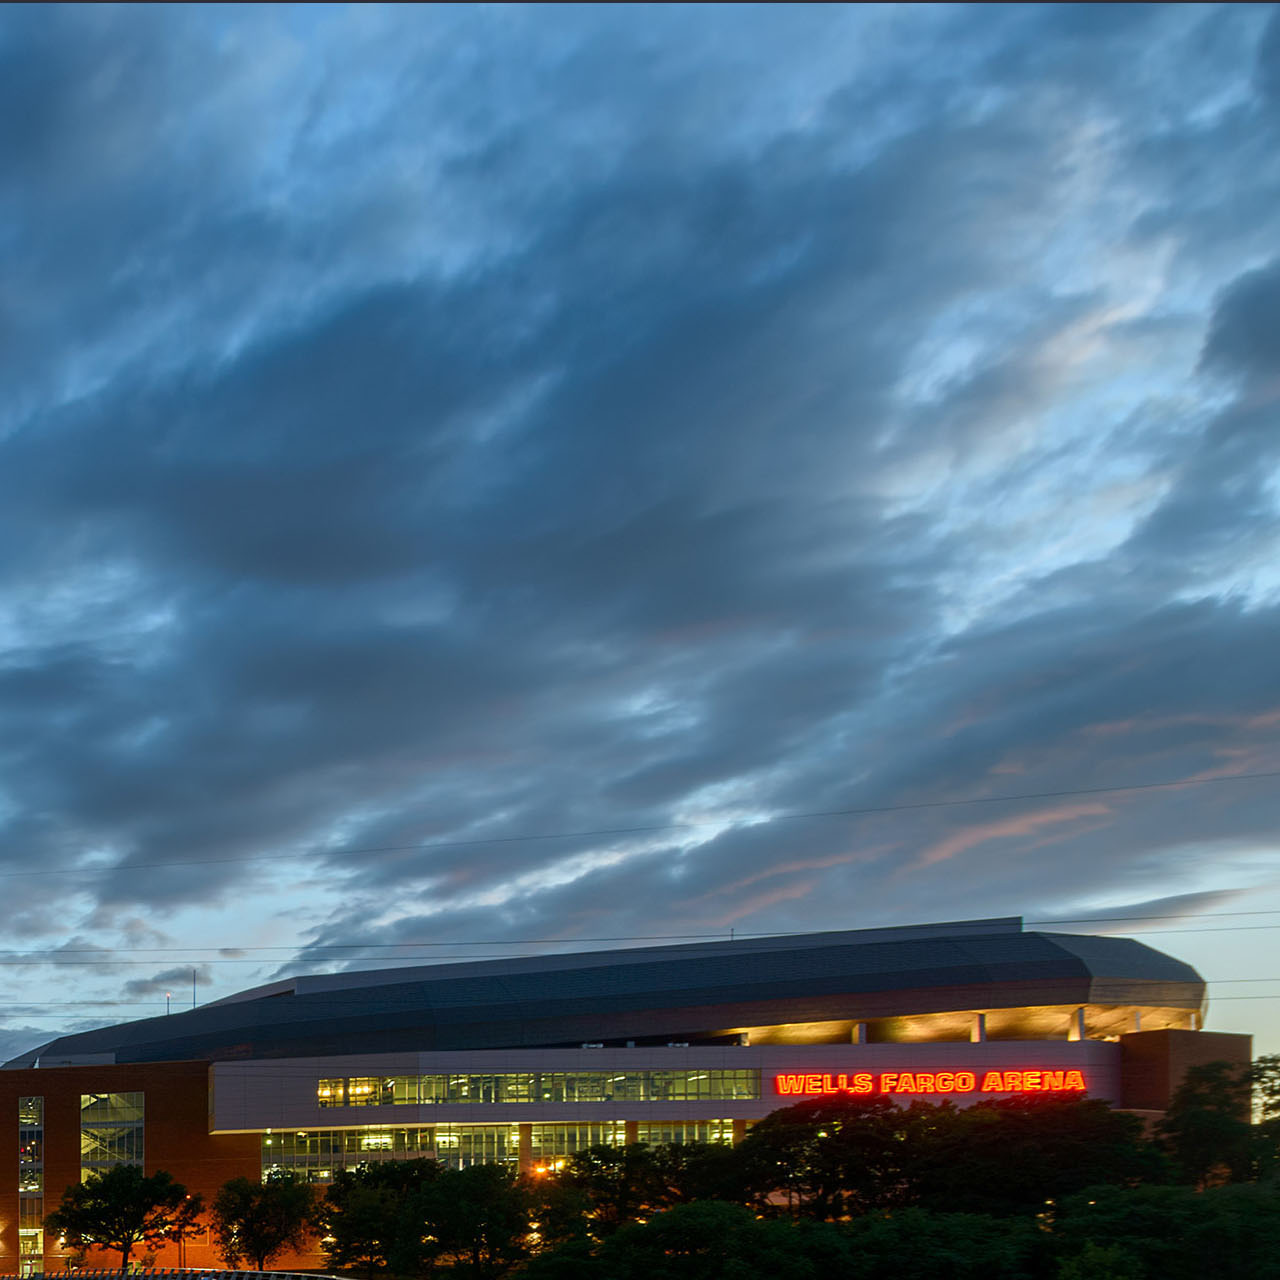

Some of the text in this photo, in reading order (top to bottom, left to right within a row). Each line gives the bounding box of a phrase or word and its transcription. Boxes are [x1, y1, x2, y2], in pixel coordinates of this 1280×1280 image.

[777, 1070, 1086, 1094] WELLS FARGO ARENA
